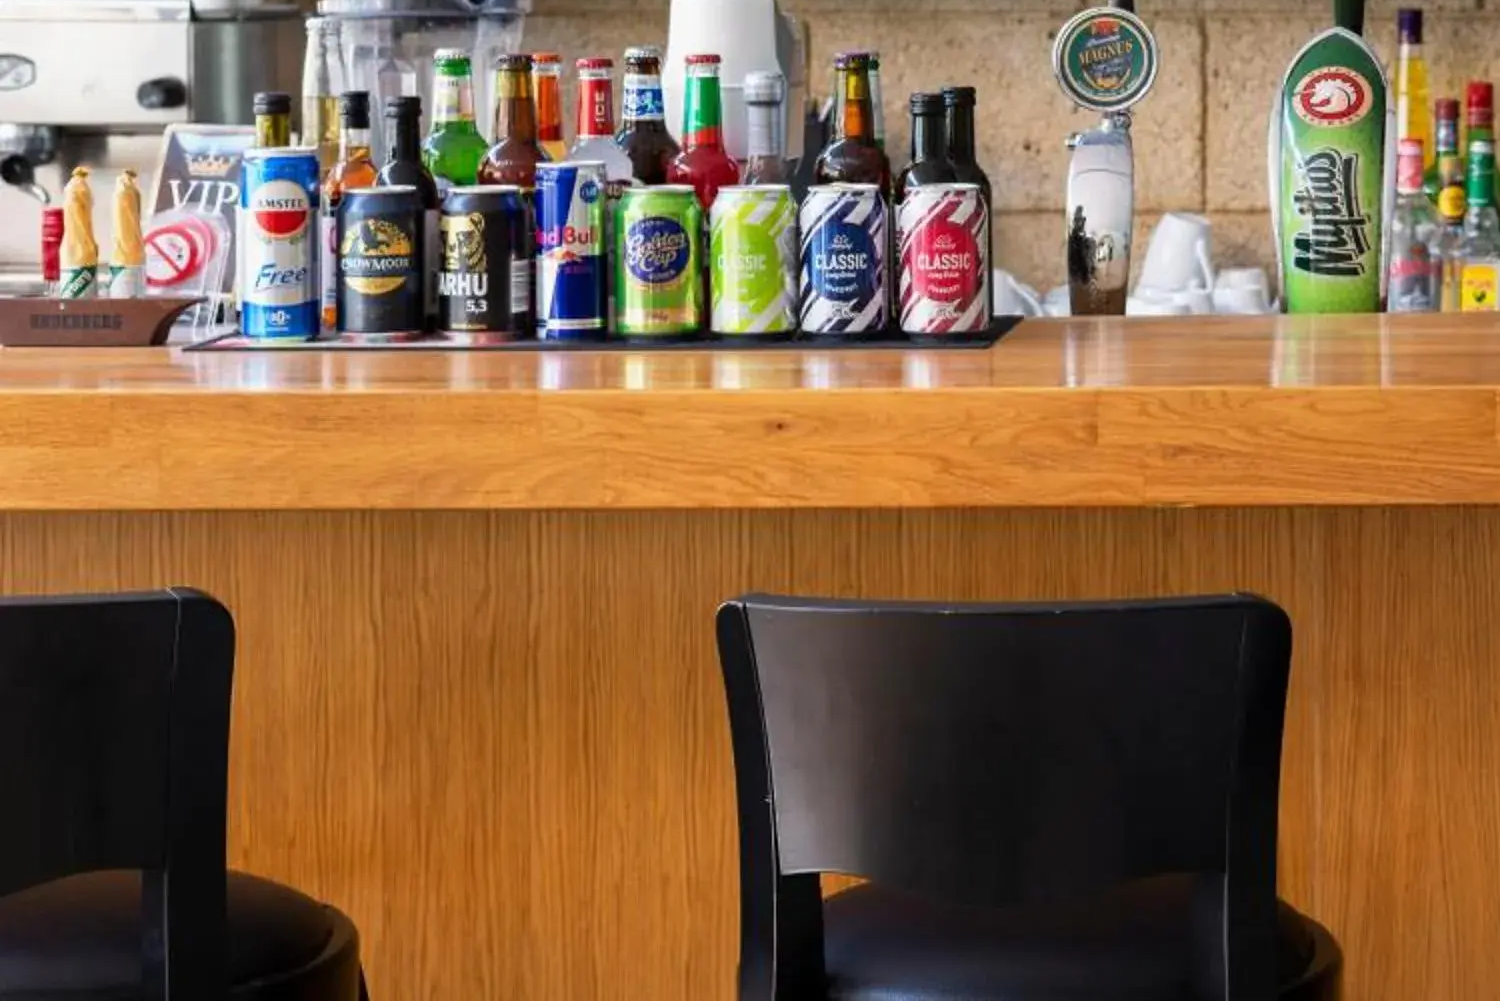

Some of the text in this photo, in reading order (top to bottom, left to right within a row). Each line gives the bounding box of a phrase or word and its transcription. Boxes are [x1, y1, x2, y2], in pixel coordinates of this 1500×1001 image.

[1078, 39, 1133, 65] MAGNUS
[168, 179, 239, 215] VIP
[815, 253, 868, 270] CLASSIC
[917, 253, 971, 271] CLASSIC
[255, 263, 308, 289] Free
